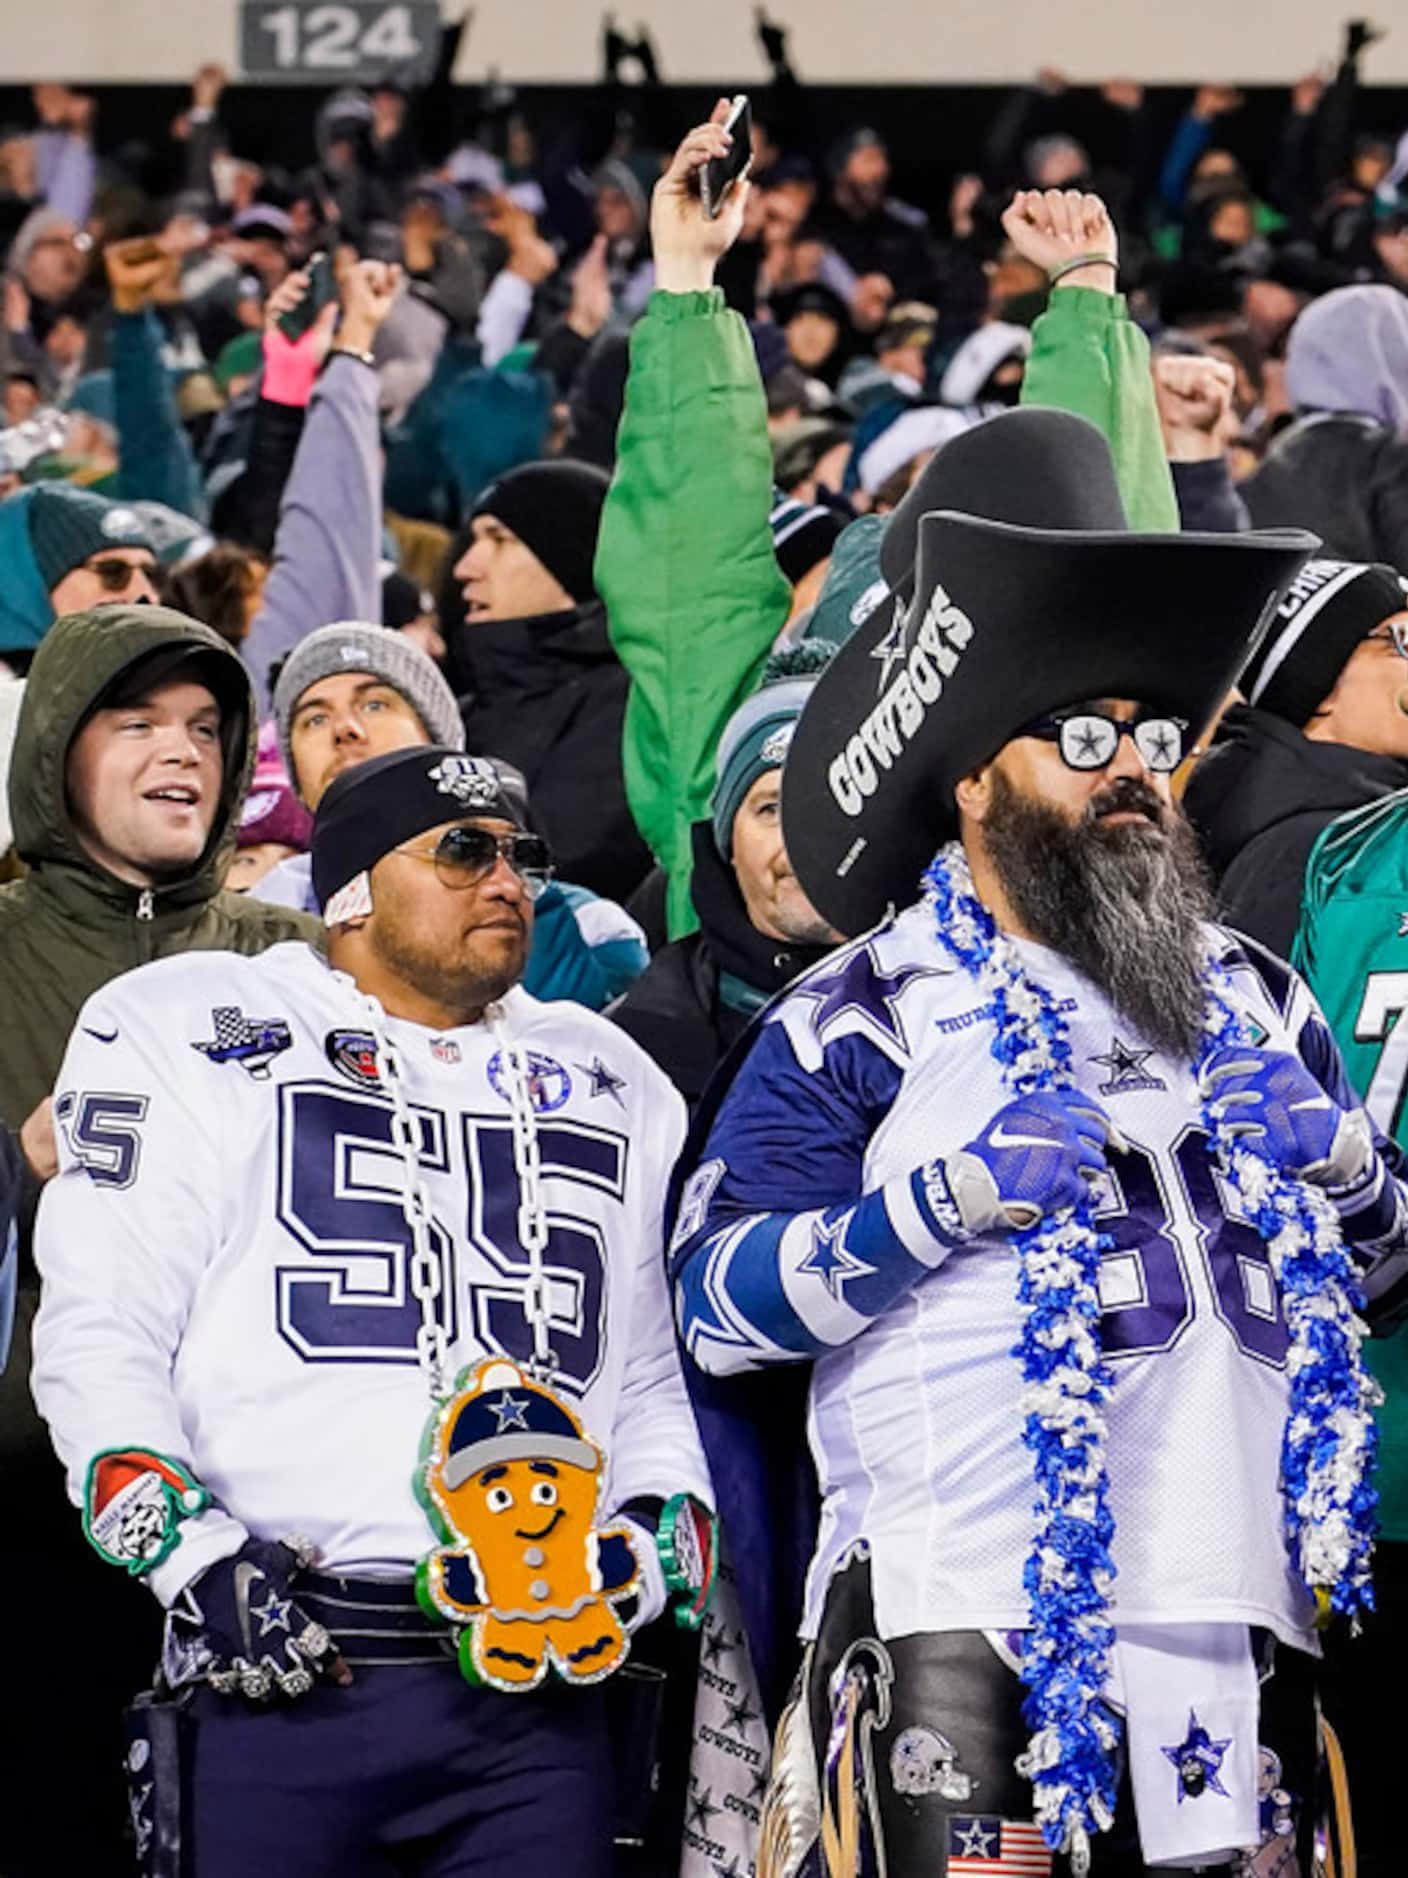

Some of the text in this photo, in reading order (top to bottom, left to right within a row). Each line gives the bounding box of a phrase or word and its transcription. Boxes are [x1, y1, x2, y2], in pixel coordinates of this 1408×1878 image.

[261, 5, 418, 68] 124
[828, 583, 975, 816] COWBOYS
[275, 1079, 630, 1399] 55
[699, 1724, 762, 1765] COWBOYS
